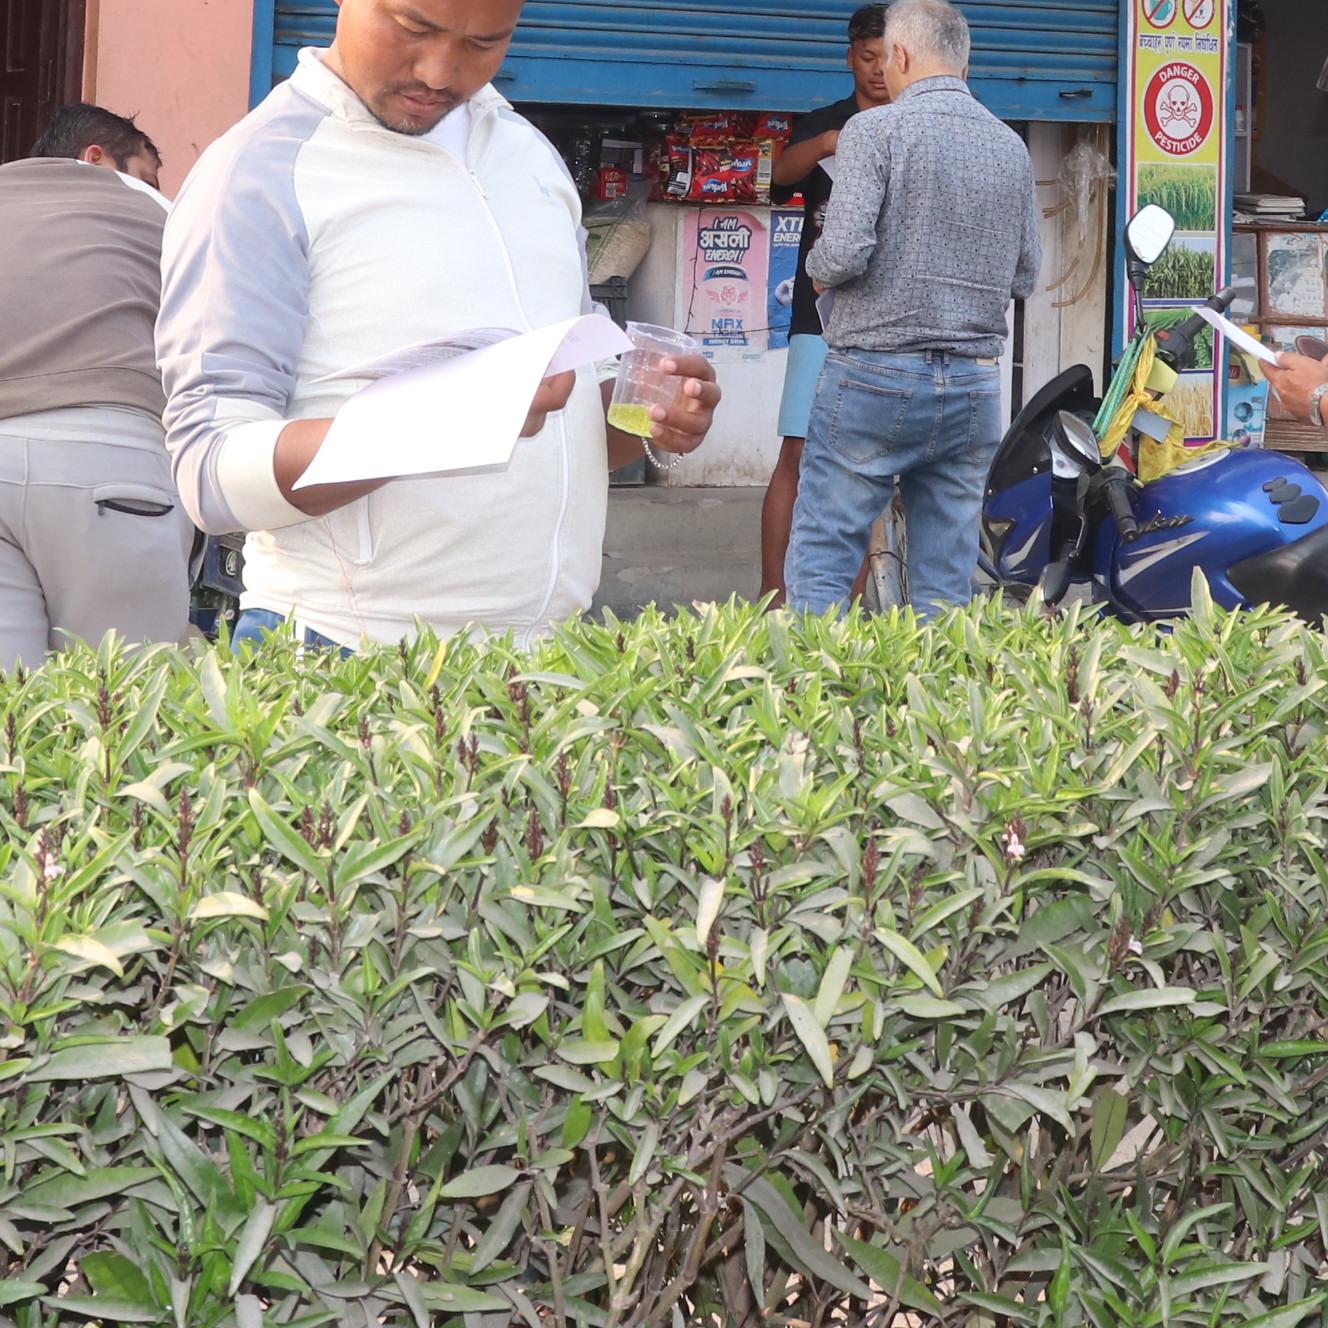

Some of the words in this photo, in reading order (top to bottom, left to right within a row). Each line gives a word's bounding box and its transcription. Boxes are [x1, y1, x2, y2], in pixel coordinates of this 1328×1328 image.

[1158, 65, 1200, 85] DANGER
[1154, 130, 1203, 153] PESTICIDE
[723, 218, 738, 230] AM
[699, 227, 751, 248] असली
[711, 318, 744, 330] MAX
